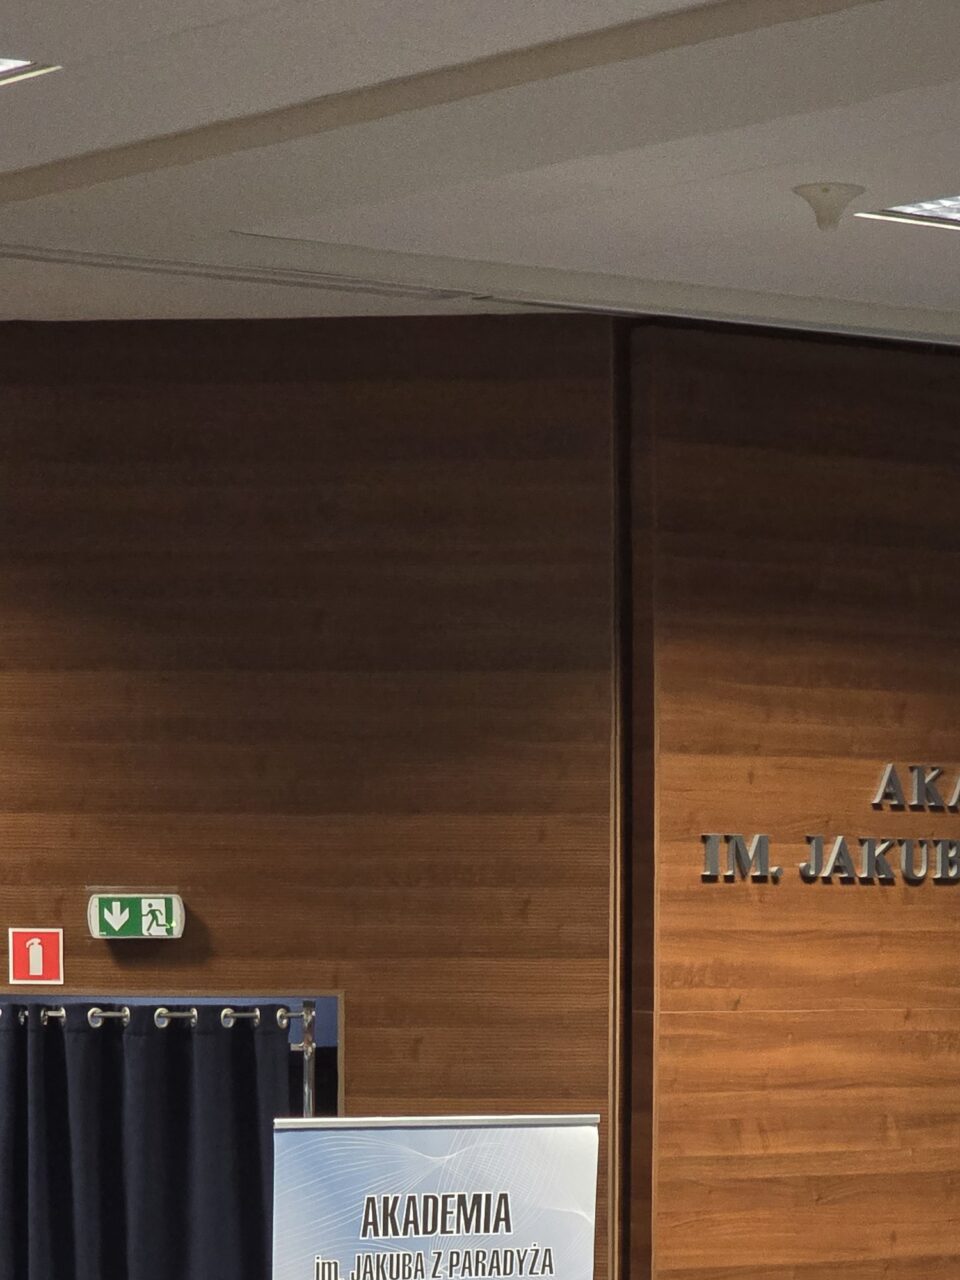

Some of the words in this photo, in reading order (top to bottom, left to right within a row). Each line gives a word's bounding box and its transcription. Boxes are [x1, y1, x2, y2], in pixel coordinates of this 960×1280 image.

[701, 833, 784, 882] IM.
[360, 1192, 513, 1239] AKADEMIA
[431, 1250, 443, 1280] Z
[448, 1242, 554, 1279] PARADYŻA
